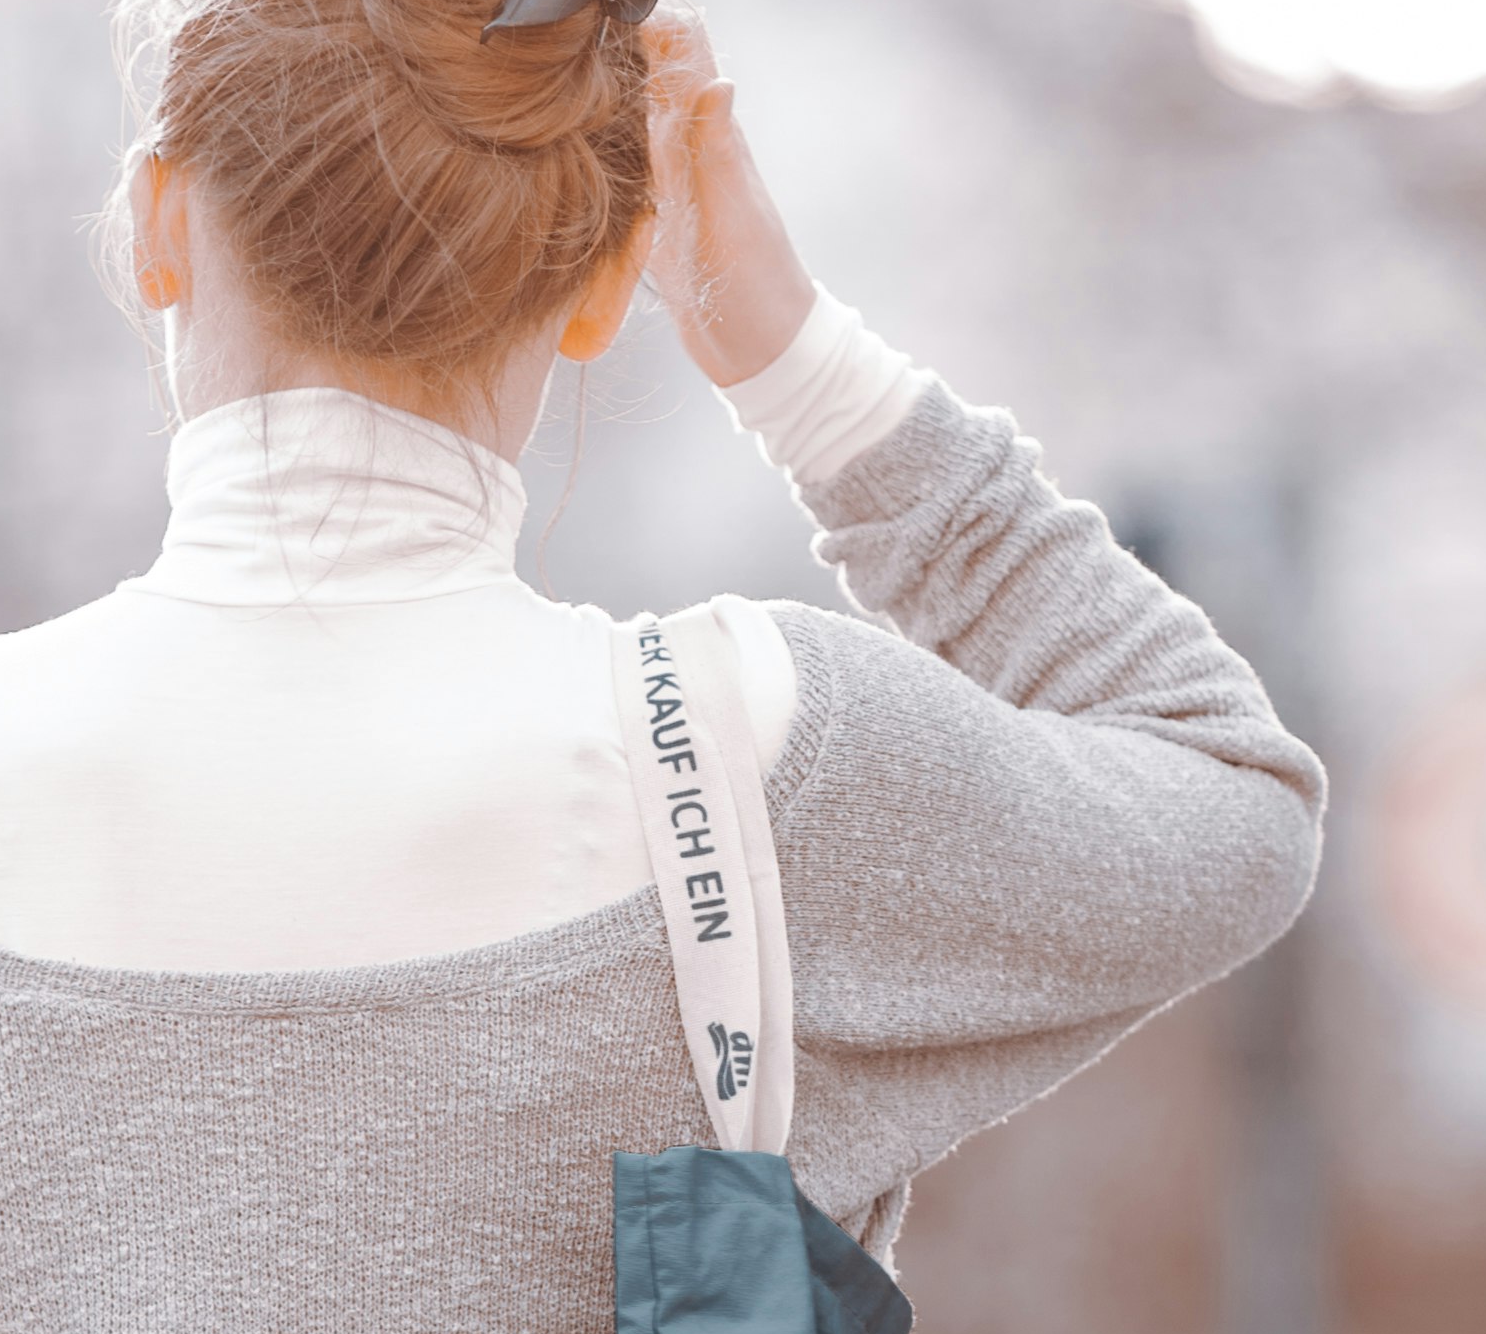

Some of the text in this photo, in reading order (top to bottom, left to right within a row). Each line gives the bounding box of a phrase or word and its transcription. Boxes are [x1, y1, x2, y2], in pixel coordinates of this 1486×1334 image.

[644, 672, 697, 773] KAUF
[666, 788, 716, 858] ICH
[685, 870, 732, 943] EIN
